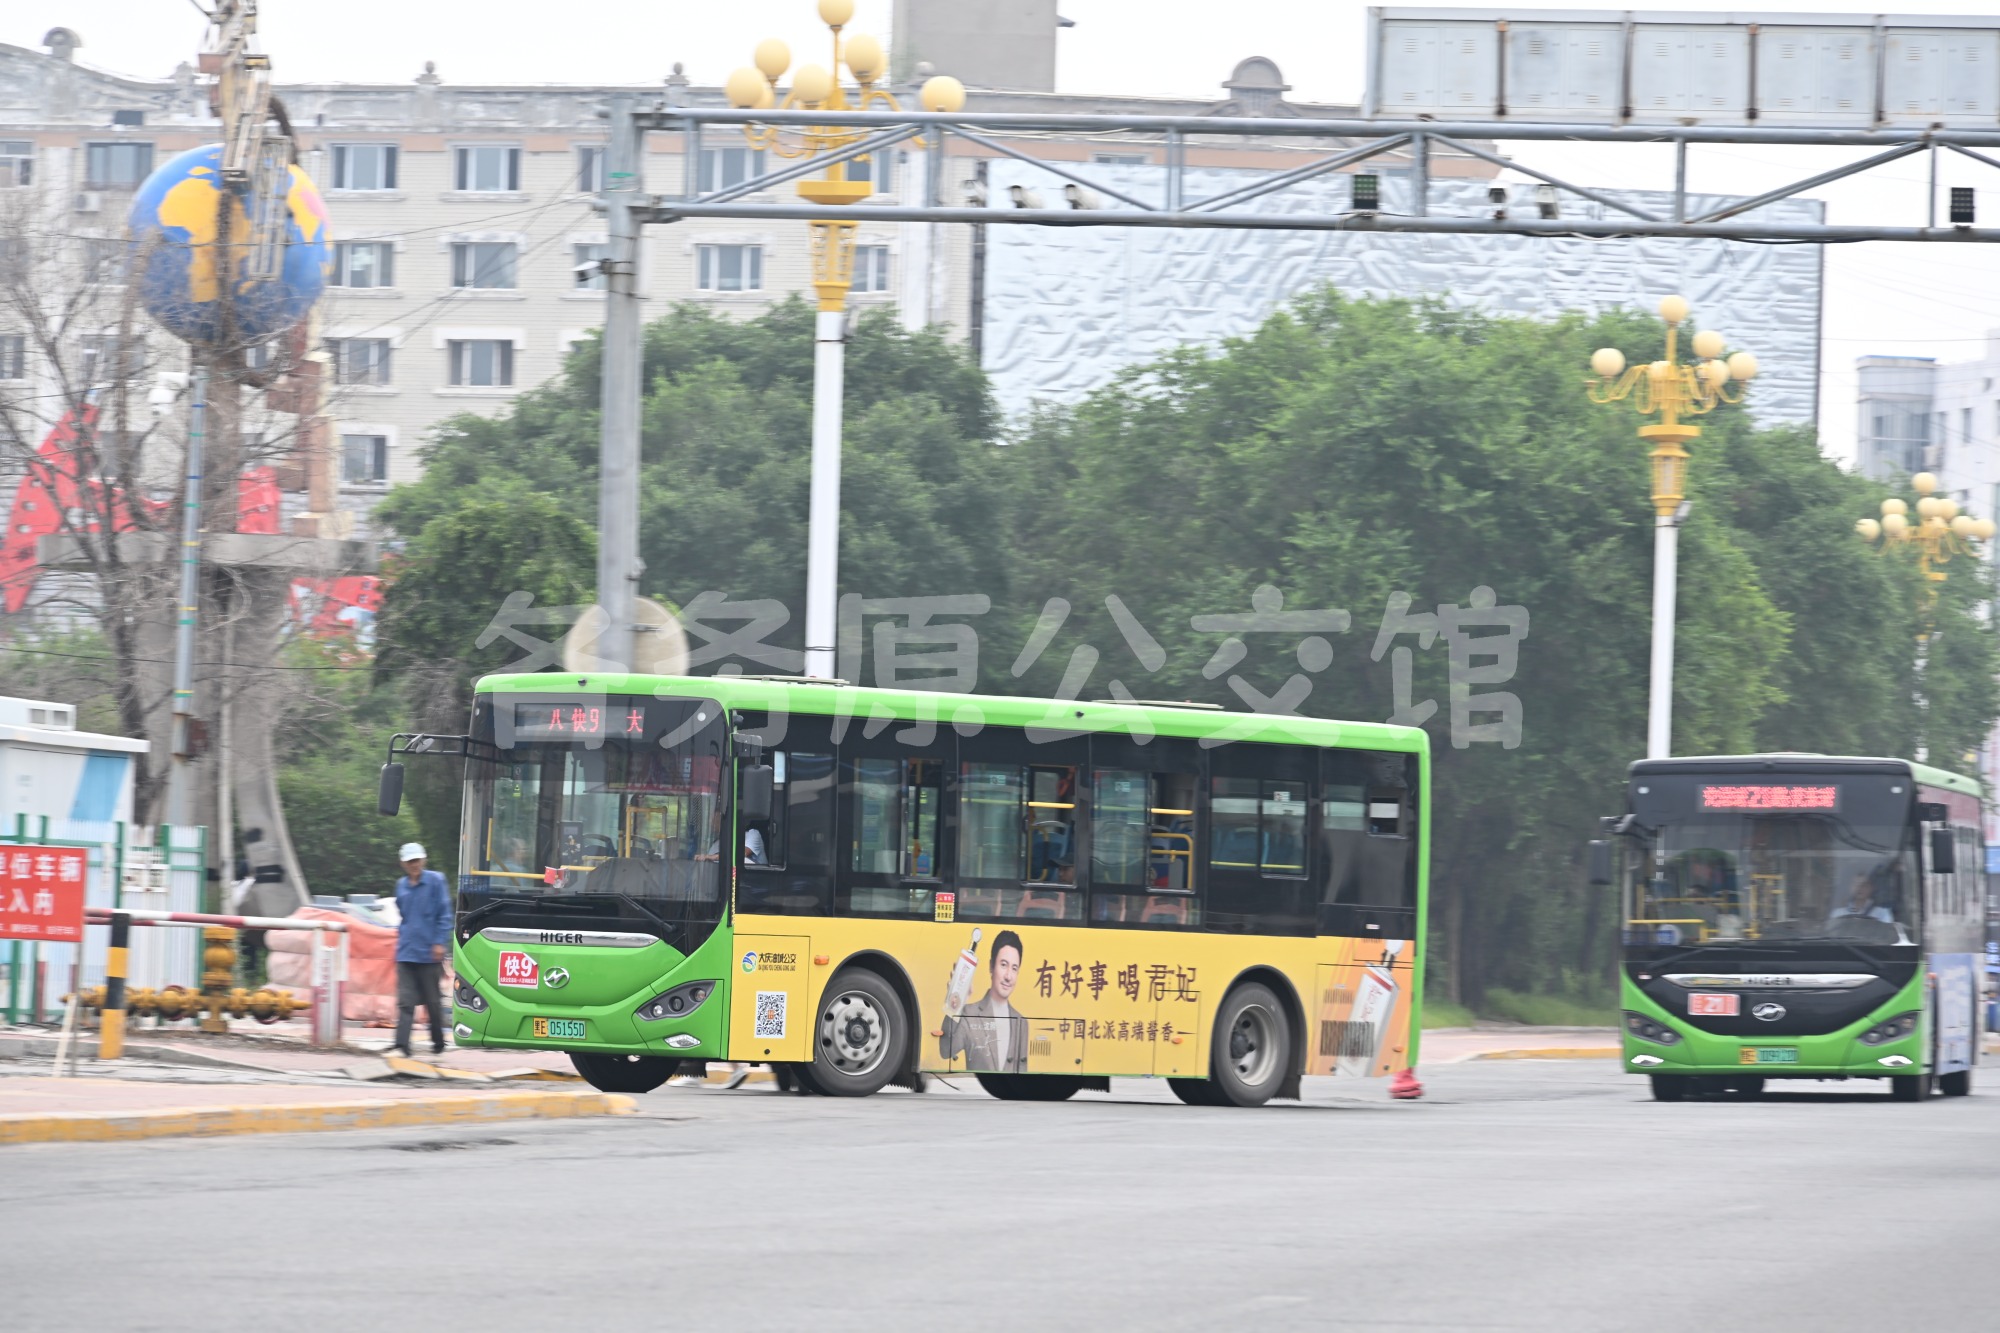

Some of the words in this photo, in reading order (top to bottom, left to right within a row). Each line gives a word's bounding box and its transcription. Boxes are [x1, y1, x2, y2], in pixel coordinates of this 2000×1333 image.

[0, 888, 54, 915] 入内
[540, 932, 583, 943] HIGER
[505, 955, 533, 977] 快9
